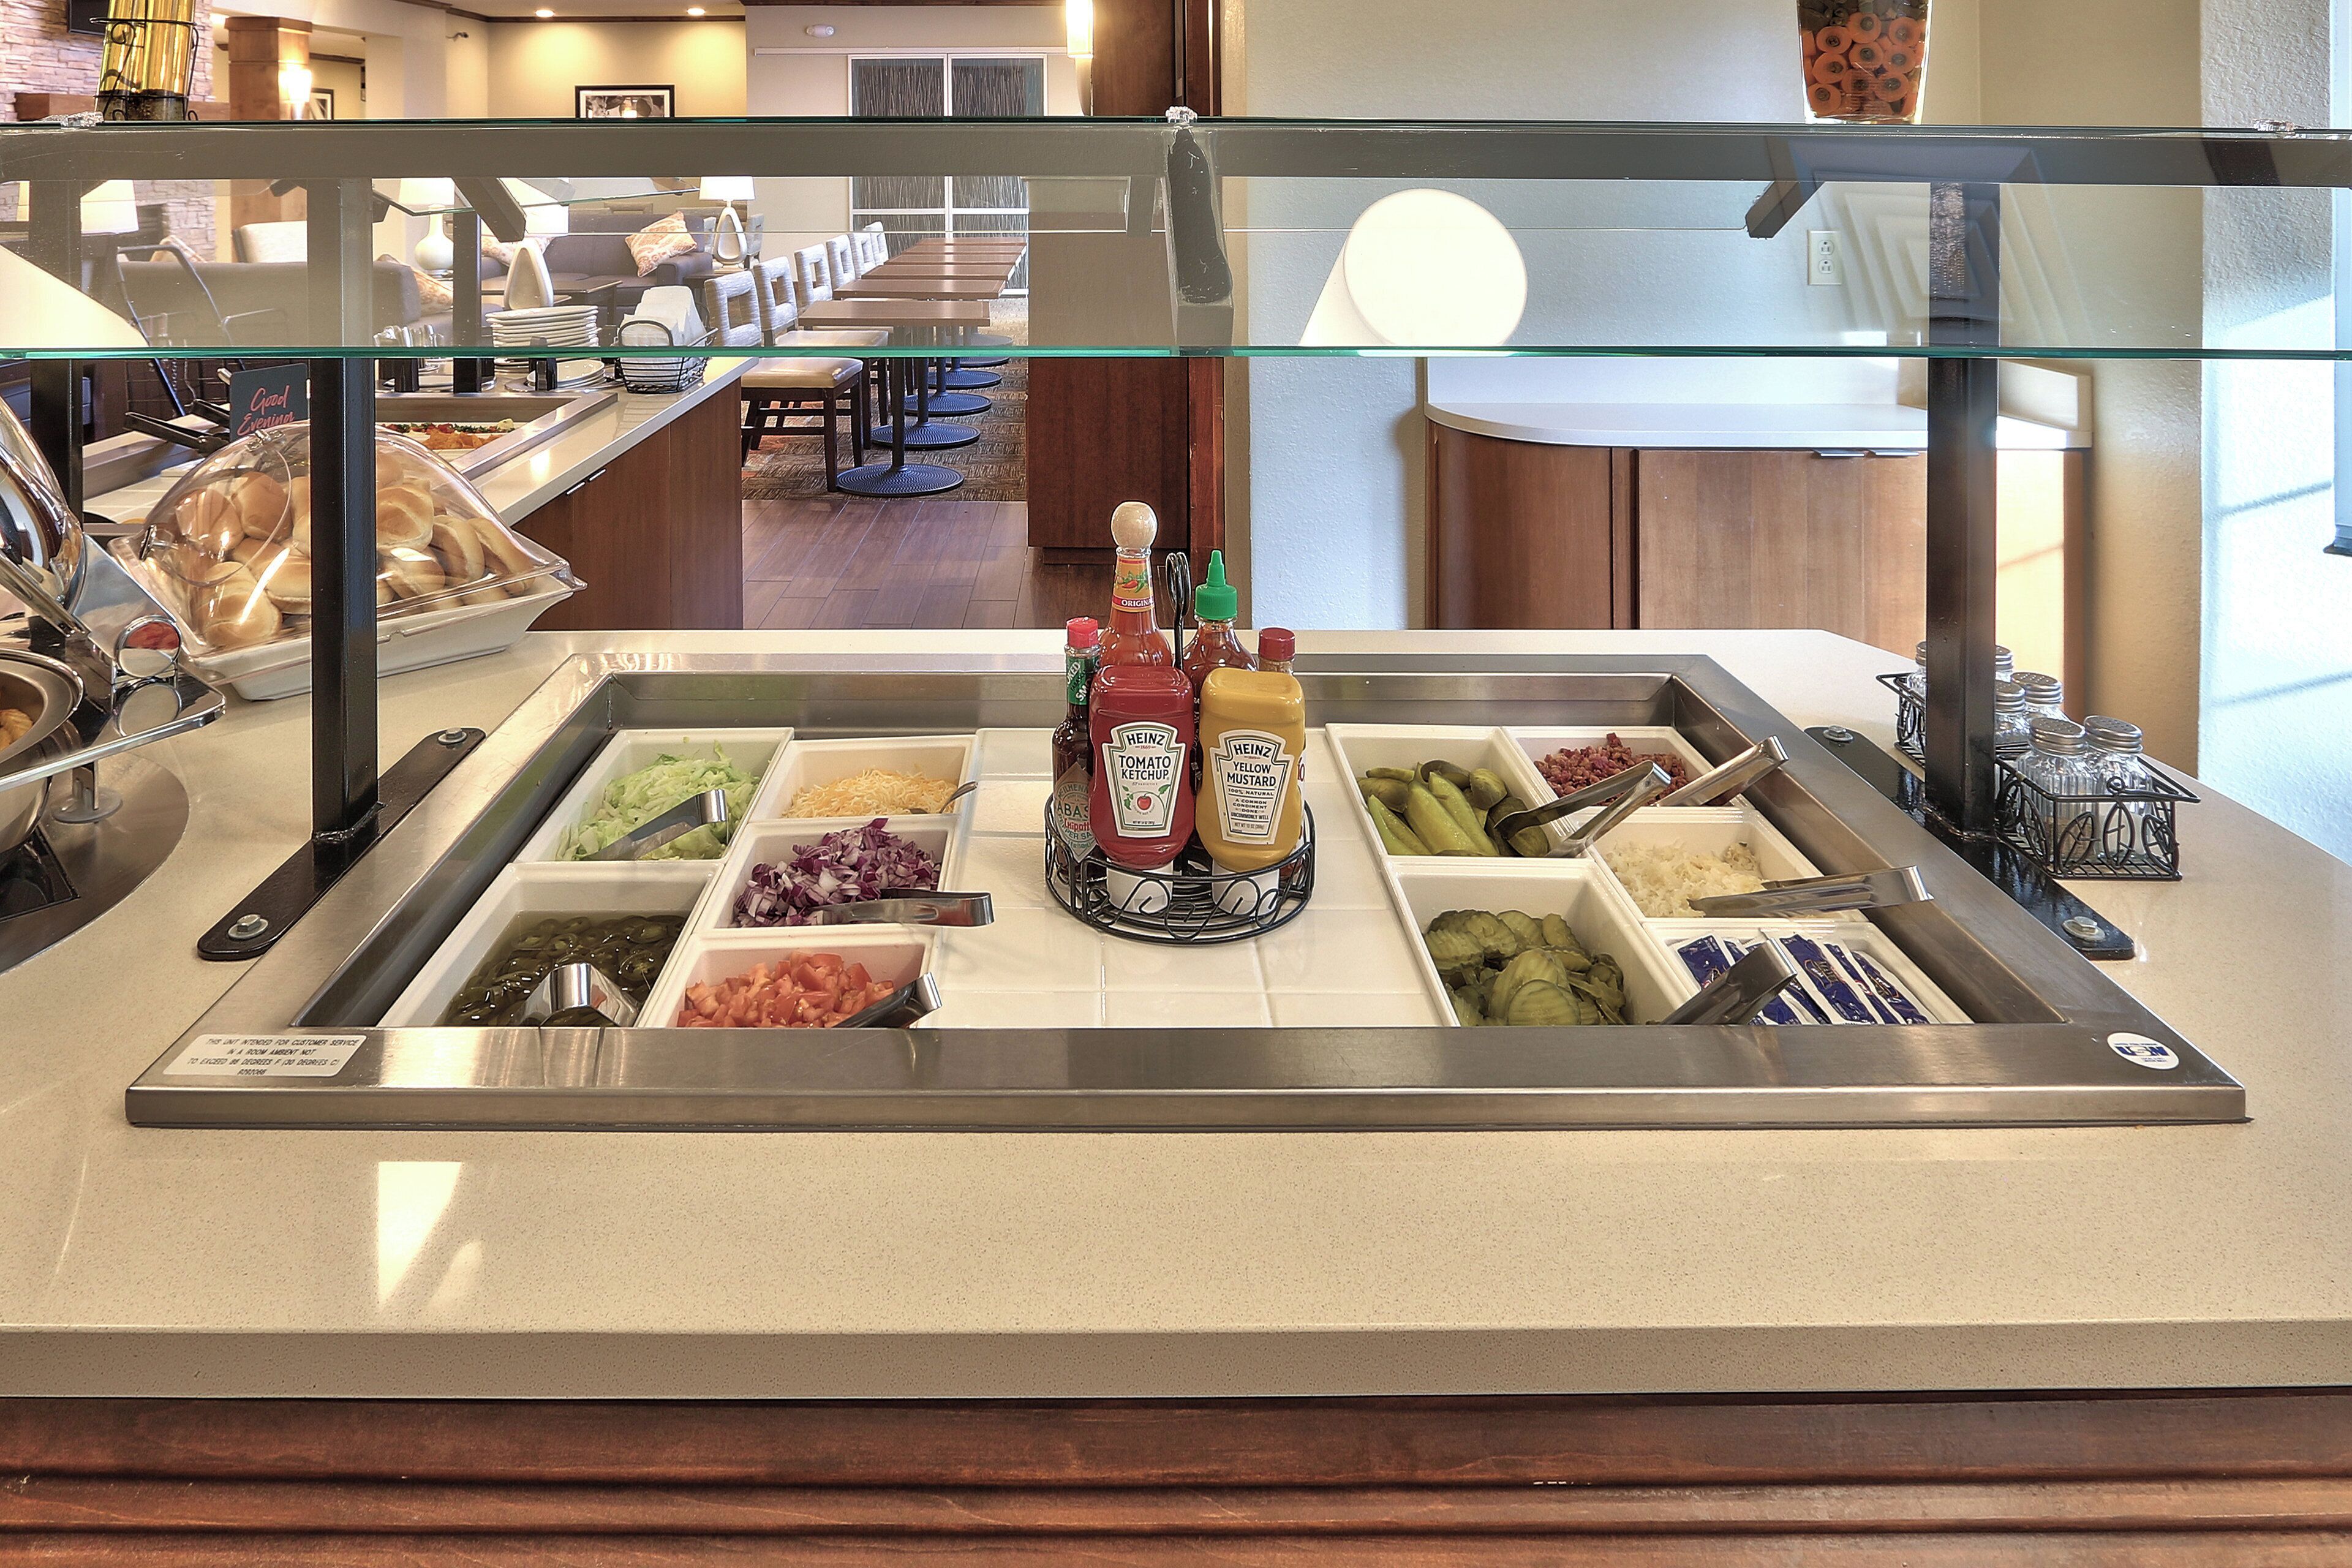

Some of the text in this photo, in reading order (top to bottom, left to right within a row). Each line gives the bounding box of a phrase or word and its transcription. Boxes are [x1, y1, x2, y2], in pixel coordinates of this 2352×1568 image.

[250, 385, 290, 415] Good
[1126, 733, 1166, 746] HEINZ
[1234, 743, 1272, 758] HEINZ
[1118, 755, 1171, 769] TOMATO
[1233, 761, 1272, 774] YELLOW
[1121, 769, 1169, 781] KETCHUP
[1227, 772, 1276, 787] MUSTARD
